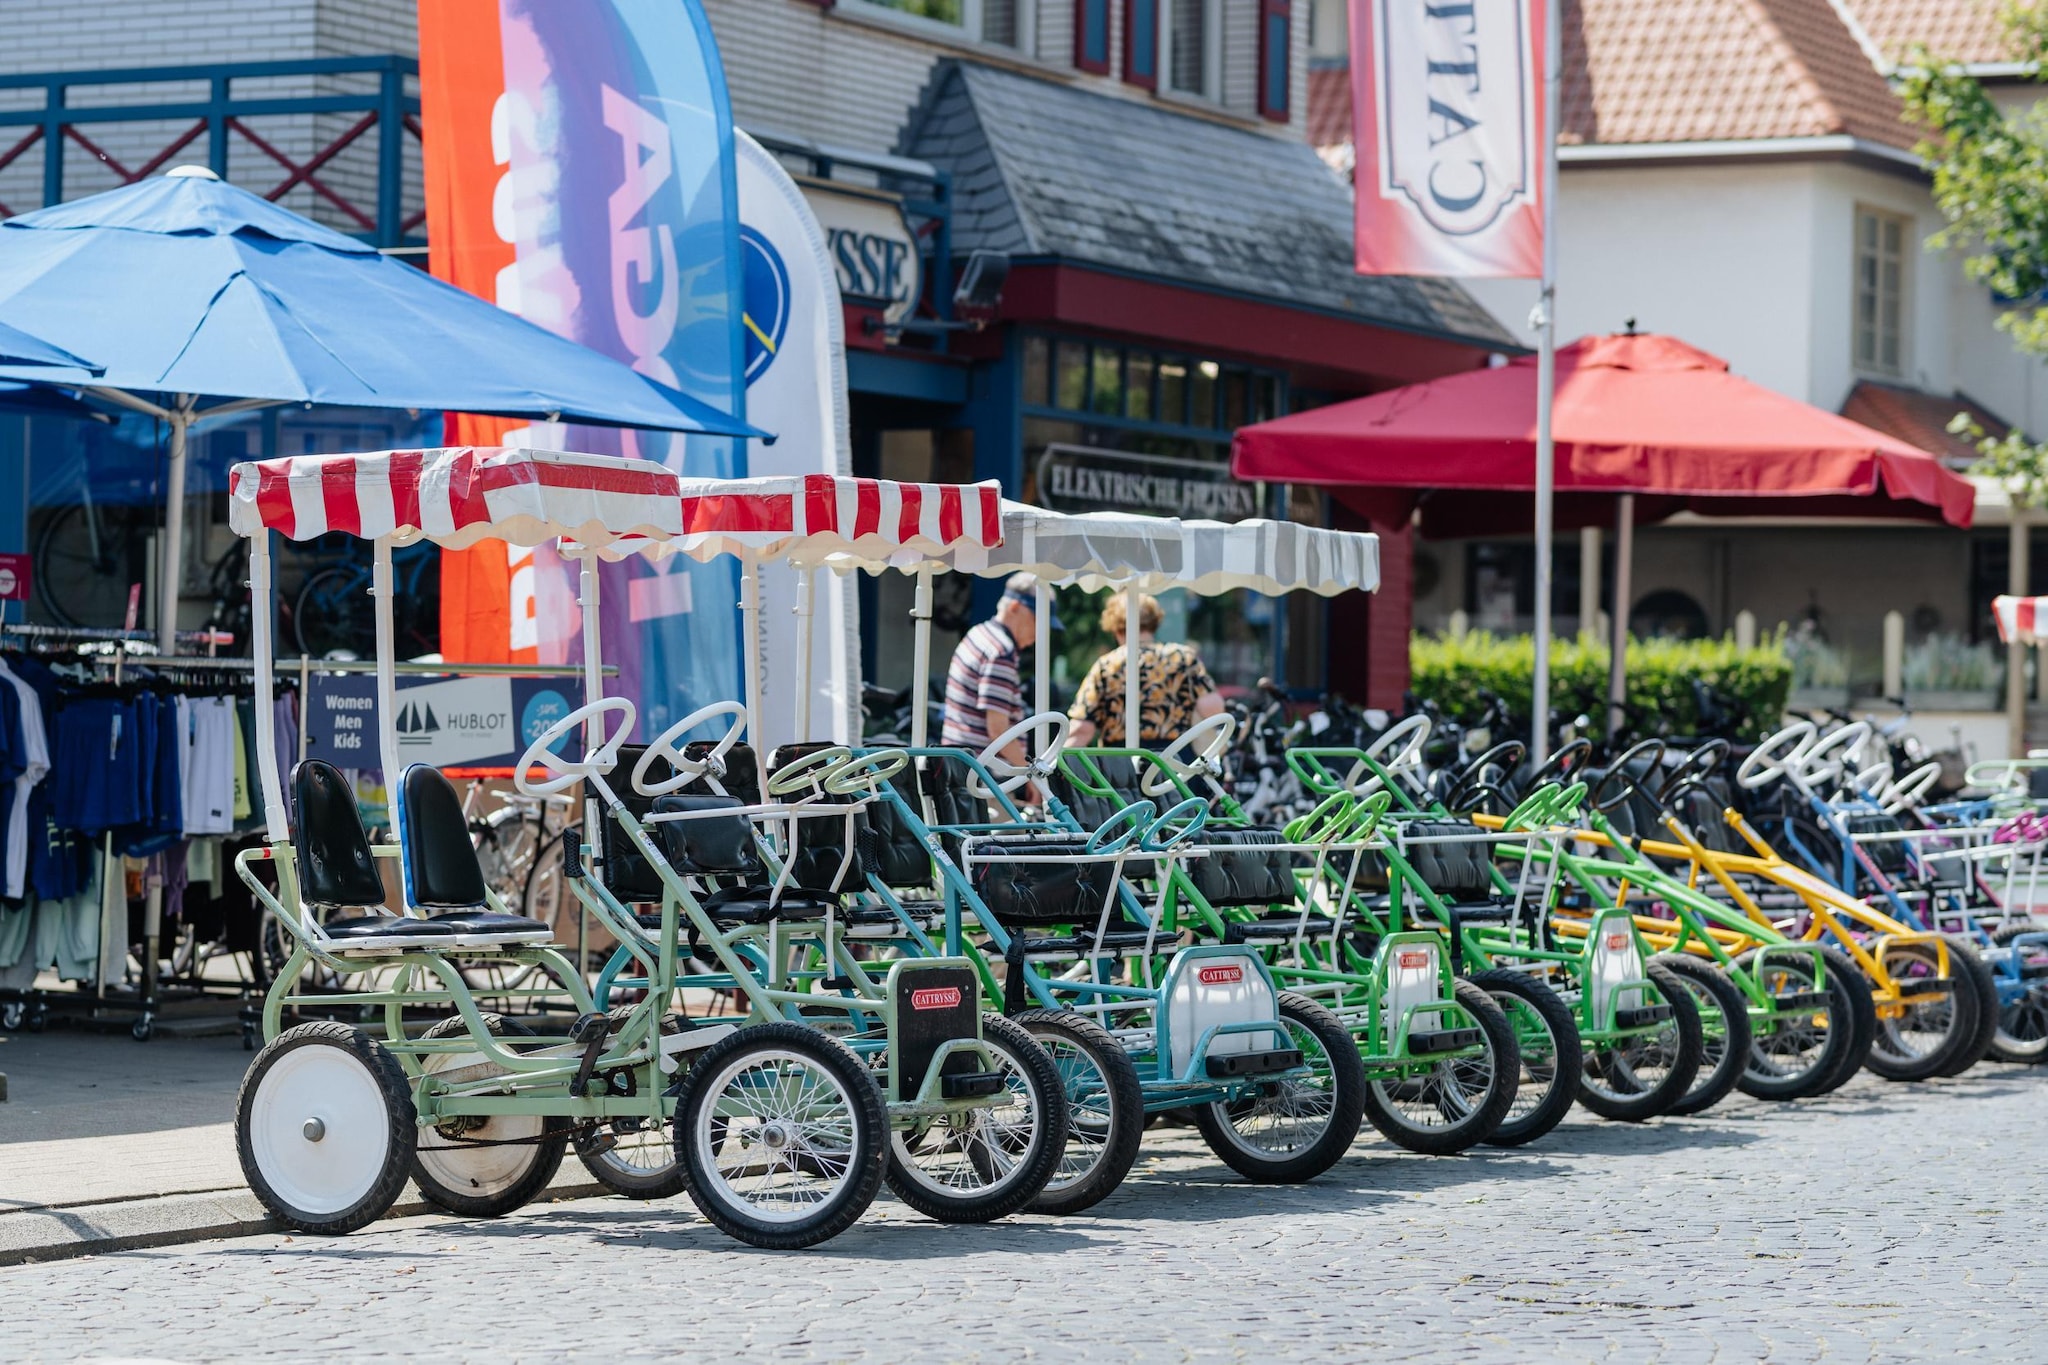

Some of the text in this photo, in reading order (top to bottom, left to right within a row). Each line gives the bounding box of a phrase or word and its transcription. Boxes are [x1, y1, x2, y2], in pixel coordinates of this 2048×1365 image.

[826, 228, 908, 303] SSE
[325, 695, 373, 710] Women
[334, 715, 362, 729] Men
[448, 713, 506, 729] HUBLOT
[334, 733, 362, 749] Kids
[1202, 968, 1241, 981] CATTRYSSE
[915, 991, 957, 1005] CATTRYSSE
